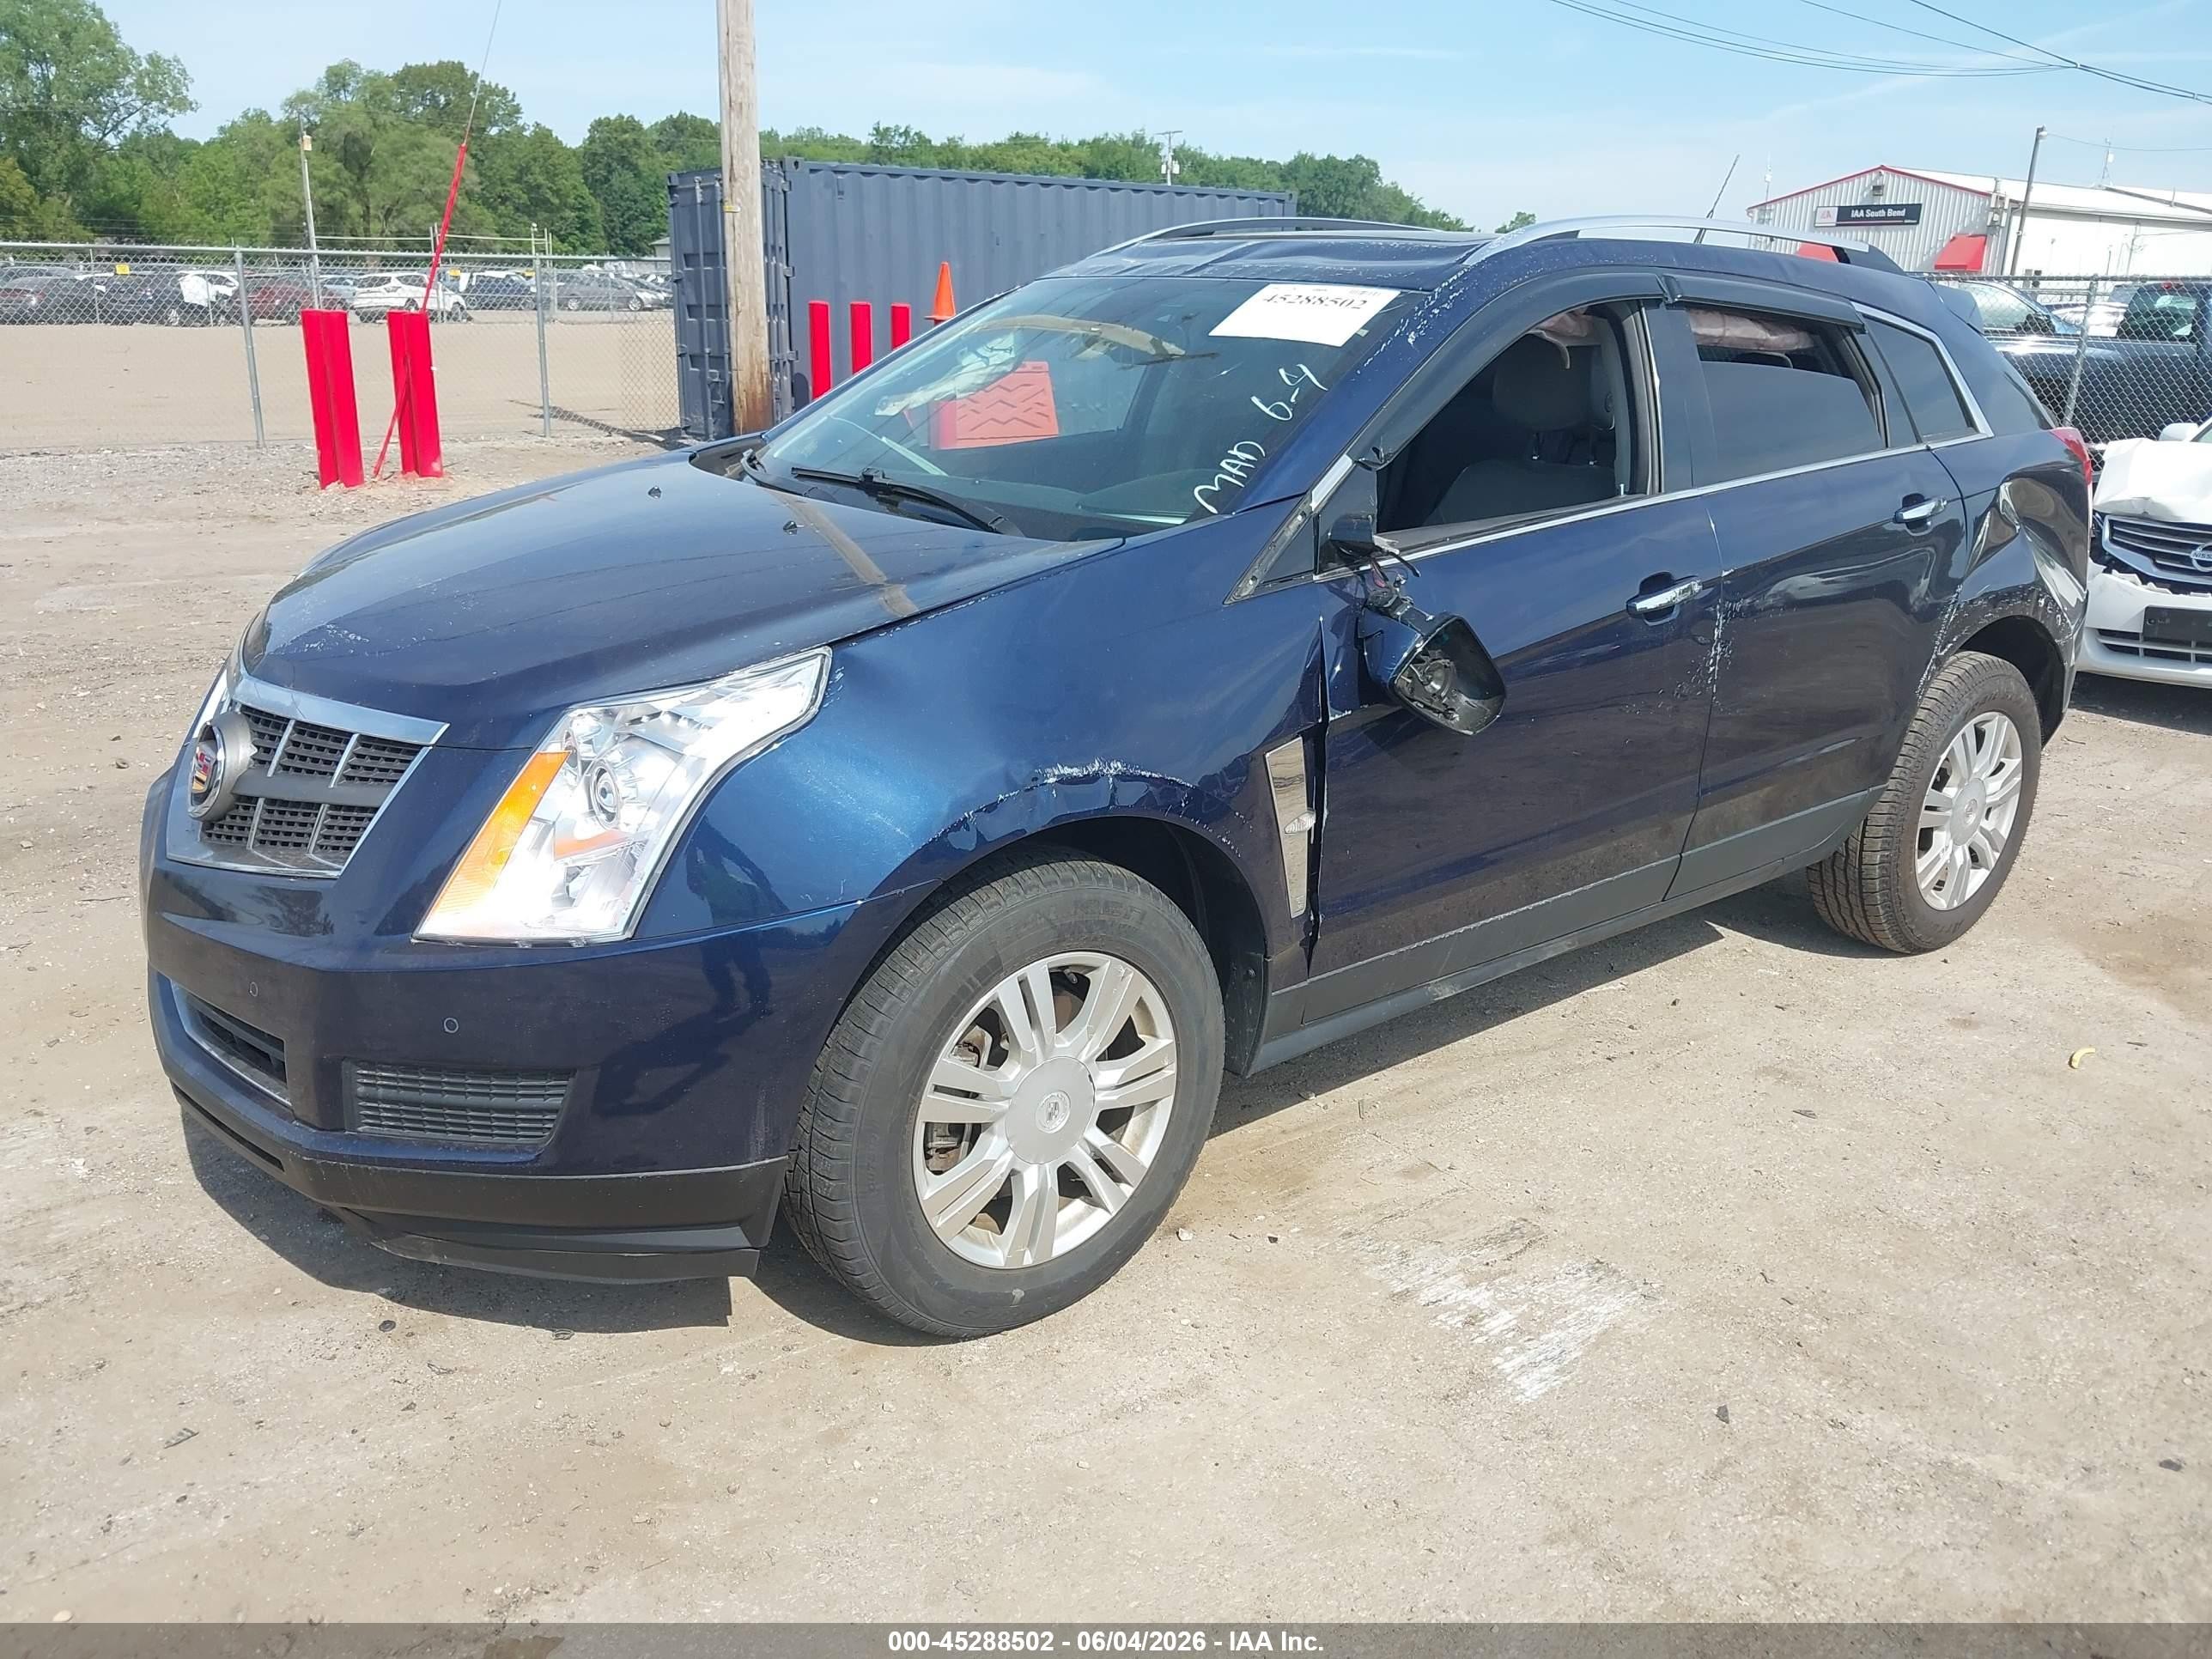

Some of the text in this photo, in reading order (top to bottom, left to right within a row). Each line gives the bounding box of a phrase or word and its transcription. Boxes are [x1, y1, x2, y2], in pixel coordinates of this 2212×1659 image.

[1850, 208, 1906, 218] IAA South Bend
[1262, 293, 1368, 310] 45288502
[1194, 441, 1266, 514] MAD
